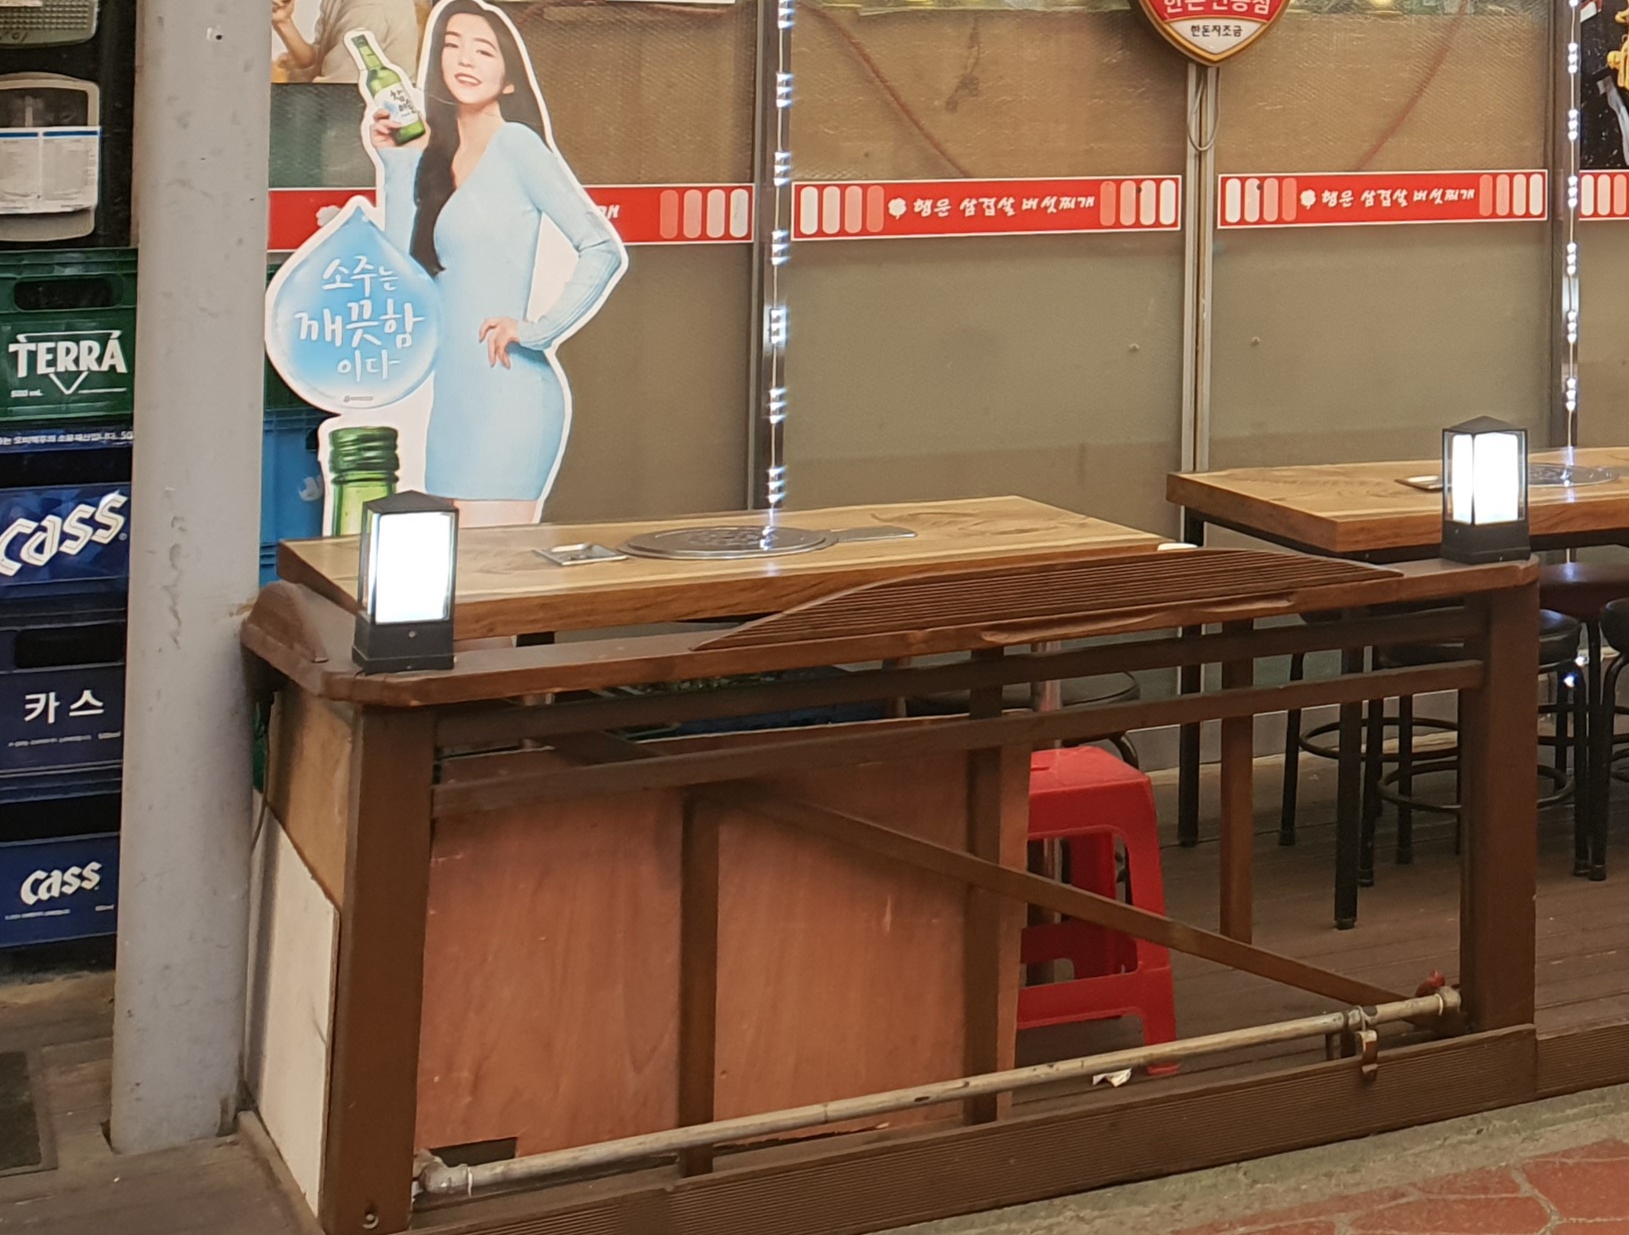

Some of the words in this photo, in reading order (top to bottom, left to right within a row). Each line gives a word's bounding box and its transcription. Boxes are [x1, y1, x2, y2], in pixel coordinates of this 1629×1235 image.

[1190, 24, 1243, 37] 한돈자조금
[913, 196, 951, 217] 행운
[959, 195, 1017, 217] 삼겹살
[1021, 194, 1096, 215] 버섯찌개
[1321, 189, 1354, 207] 행운
[1361, 188, 1408, 208] 삼겹살
[1412, 188, 1476, 206] 버섯찌개
[321, 254, 399, 298] 소주는
[294, 298, 427, 350] 깨끗함
[8, 339, 129, 379] TERRA
[336, 348, 401, 383] 이다
[24, 689, 104, 724] 카스
[20, 861, 102, 906] Cass
